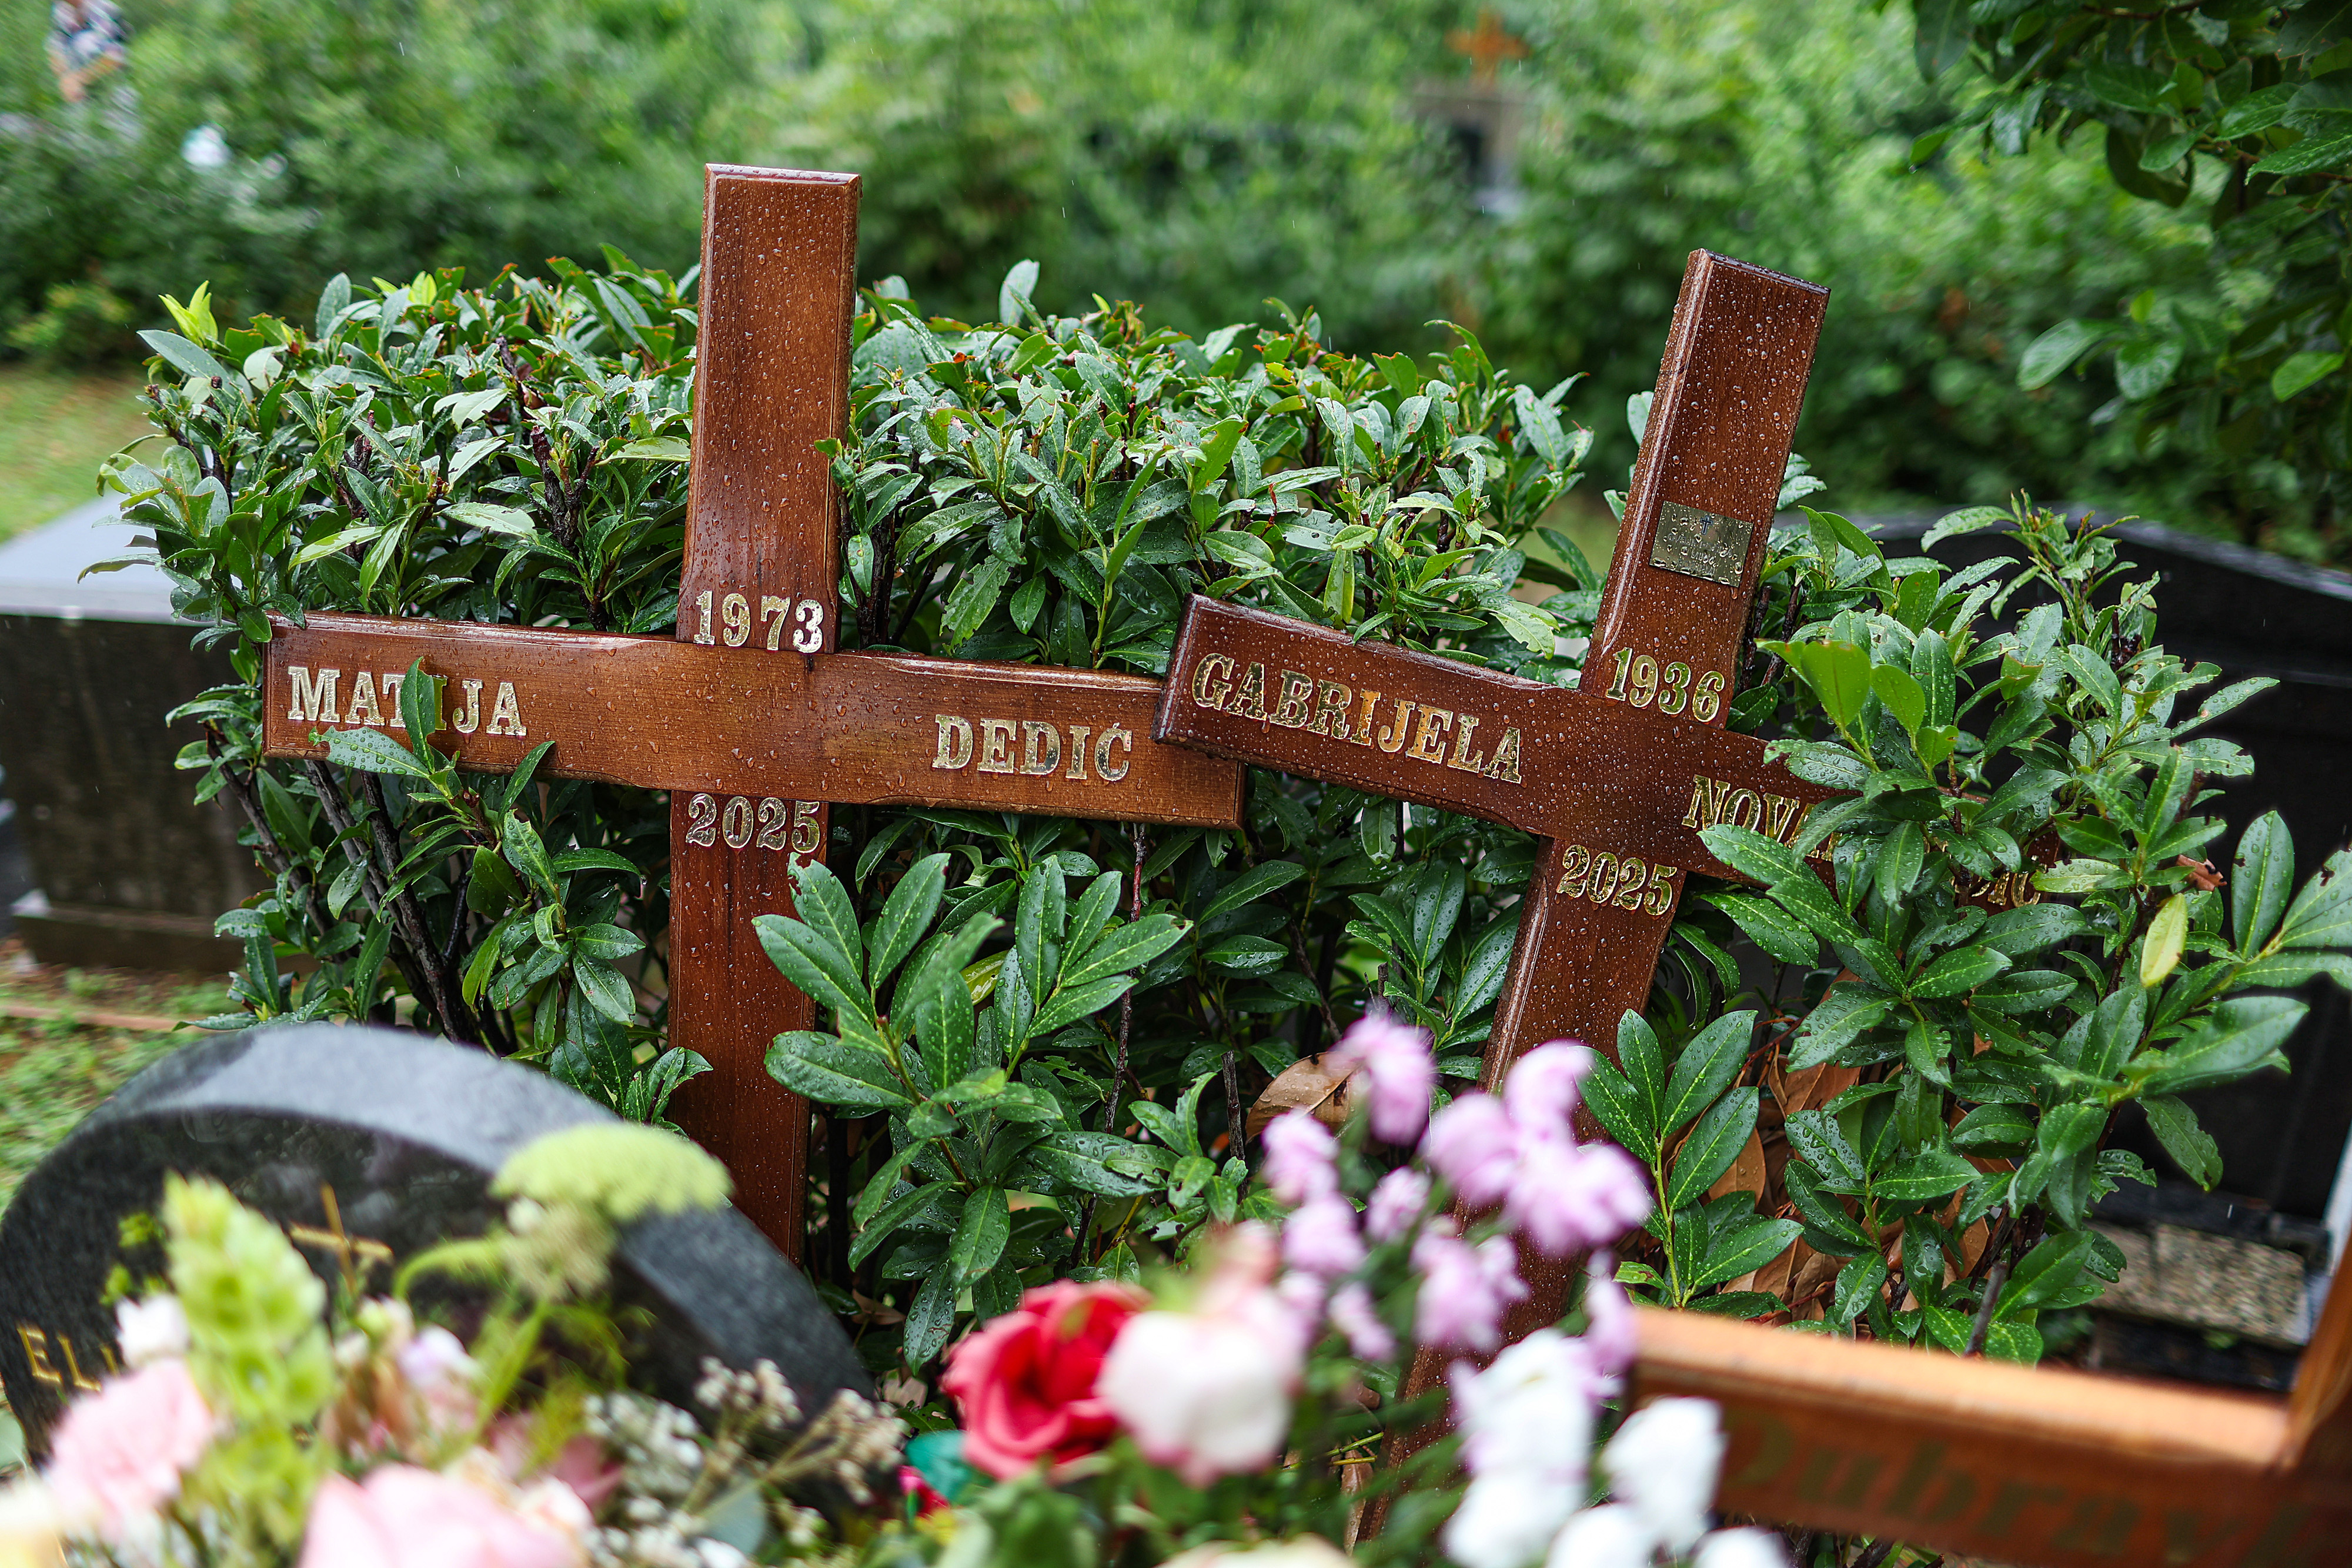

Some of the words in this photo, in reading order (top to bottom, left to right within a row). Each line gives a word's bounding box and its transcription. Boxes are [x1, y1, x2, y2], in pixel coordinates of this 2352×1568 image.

[693, 590, 823, 653] 1973
[1191, 653, 1522, 784] GABRIJELA
[1605, 647, 1725, 722] 1936
[932, 714, 1132, 781] DEDIĆ
[686, 793, 820, 853] 2025
[1556, 844, 1678, 916] 2025
